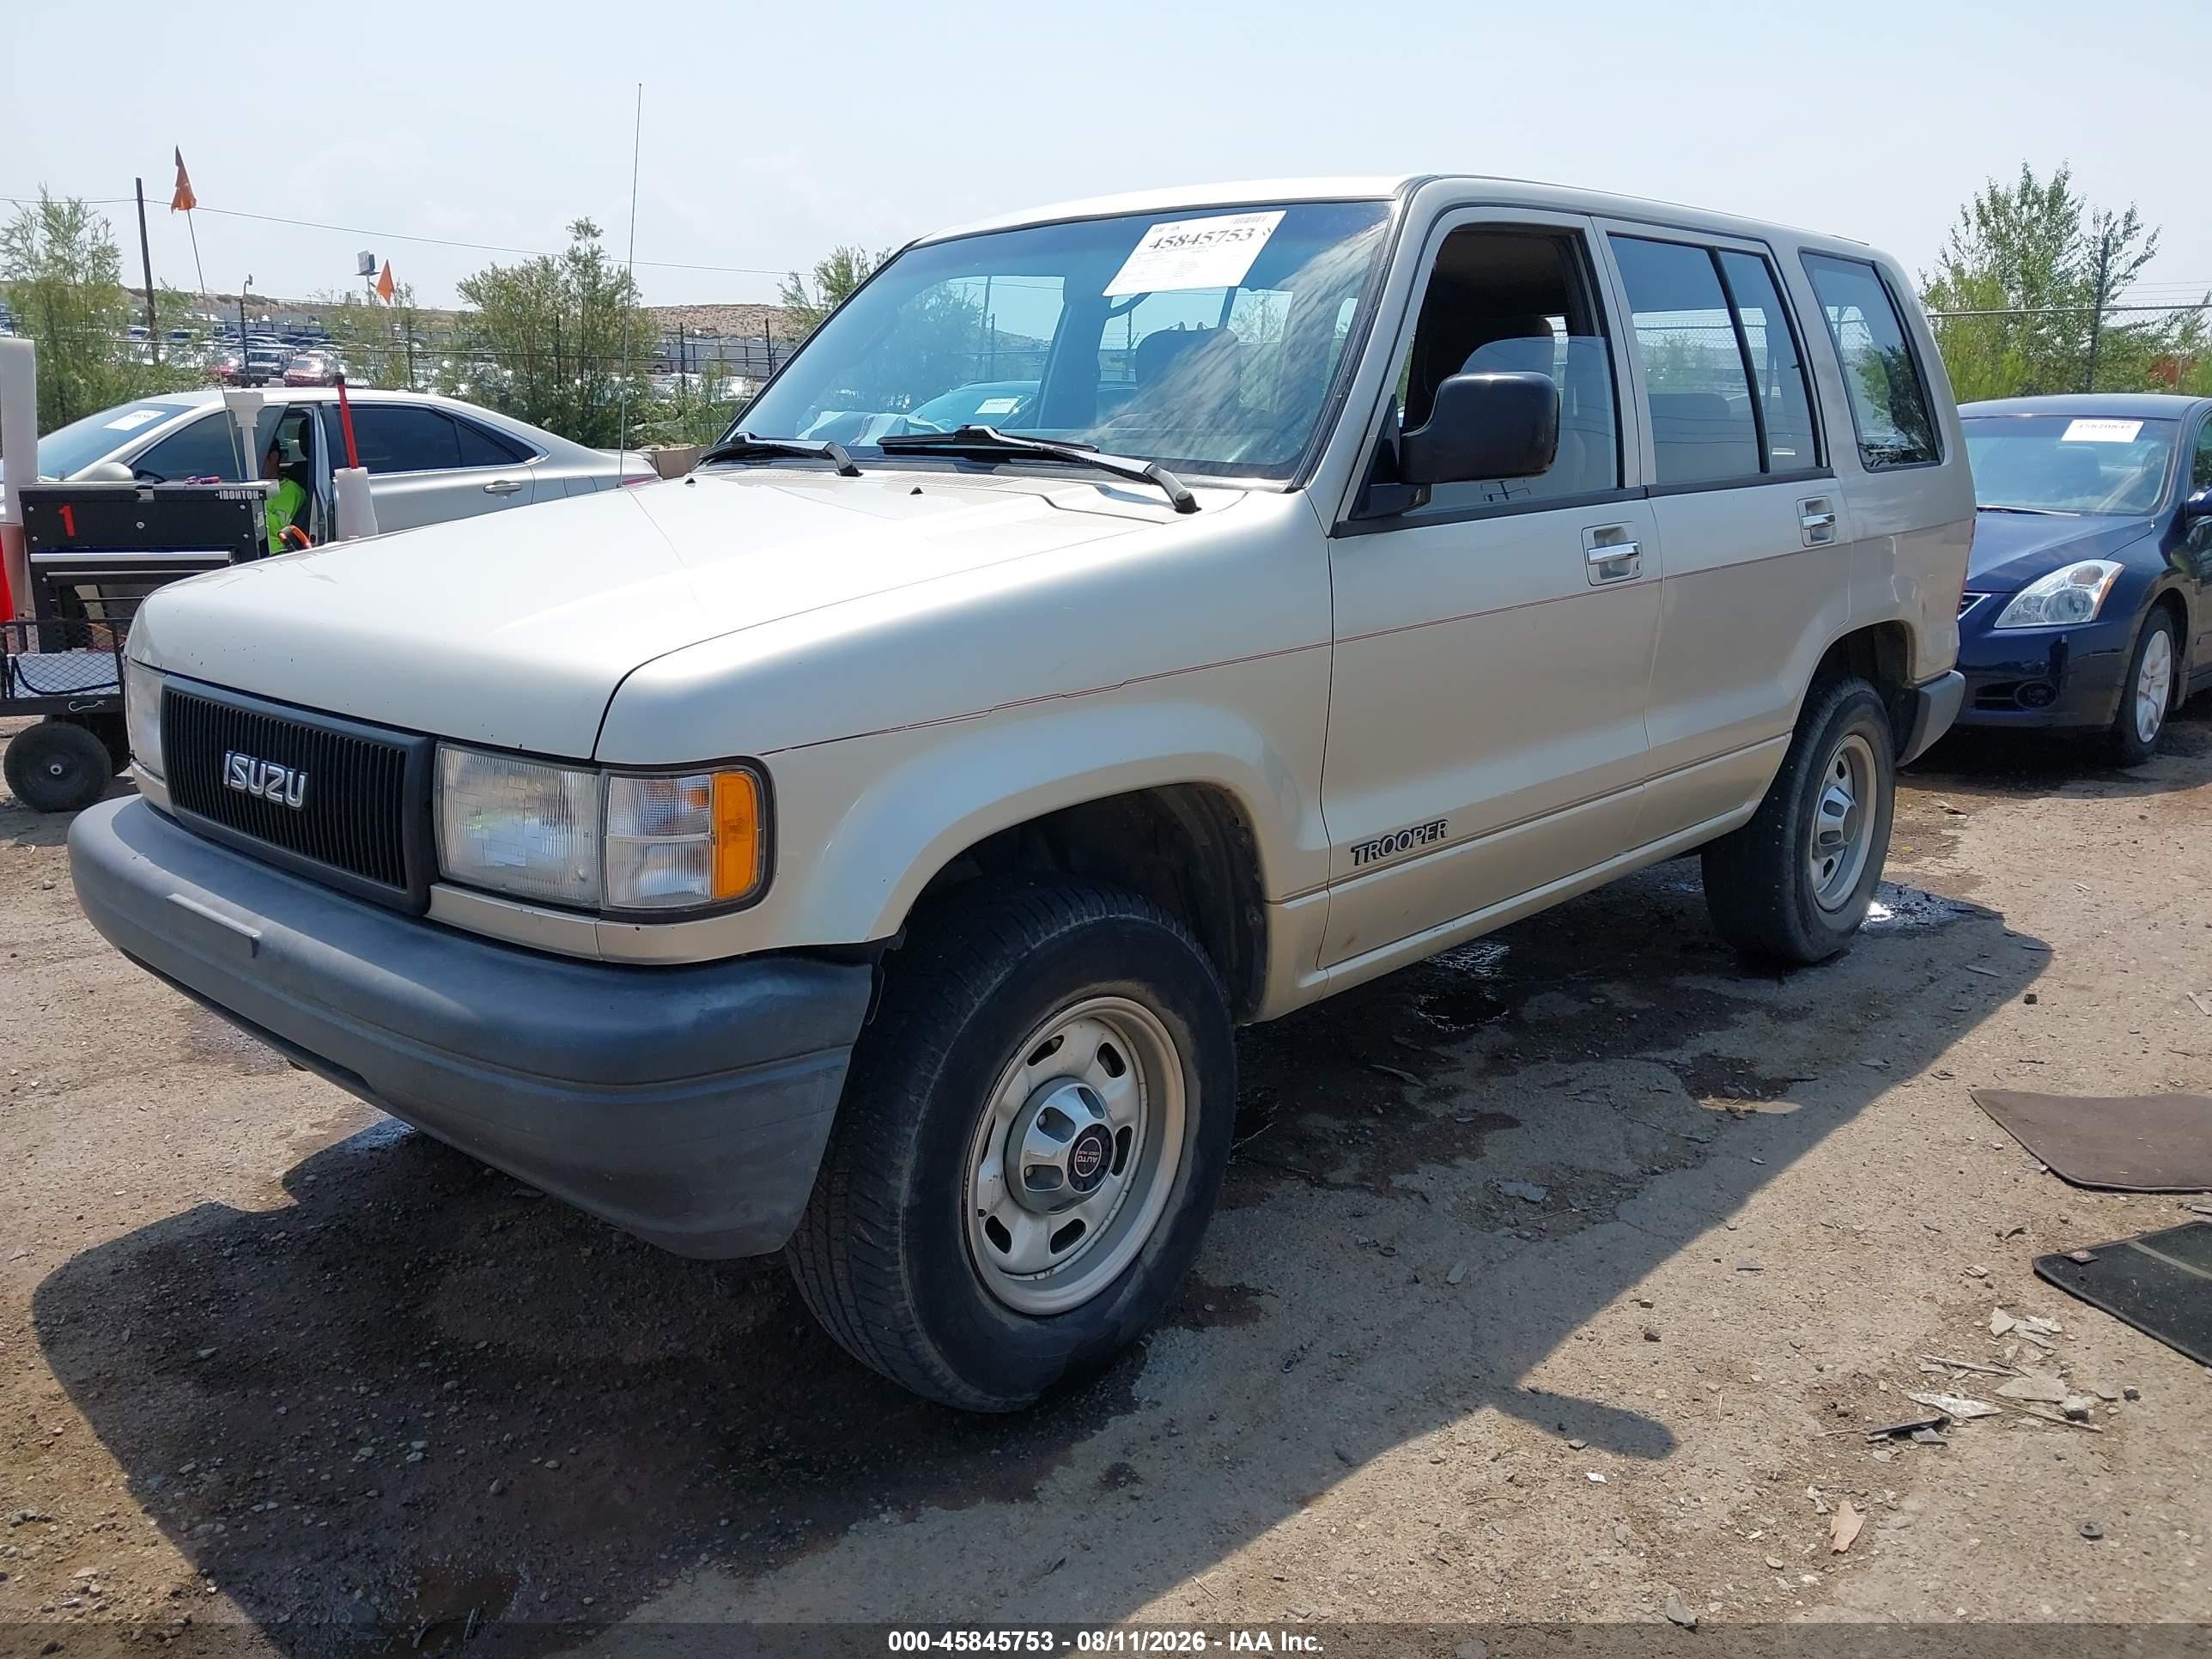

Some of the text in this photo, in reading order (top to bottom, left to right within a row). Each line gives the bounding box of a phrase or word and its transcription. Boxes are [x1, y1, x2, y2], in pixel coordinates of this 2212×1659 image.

[1148, 228, 1255, 250] 45845753
[219, 489, 259, 500] IRONTON
[58, 503, 76, 537] 1
[223, 750, 309, 810] ISUZU
[1351, 817, 1450, 866] TROOPER
[1077, 1155, 1098, 1164] AUTO
